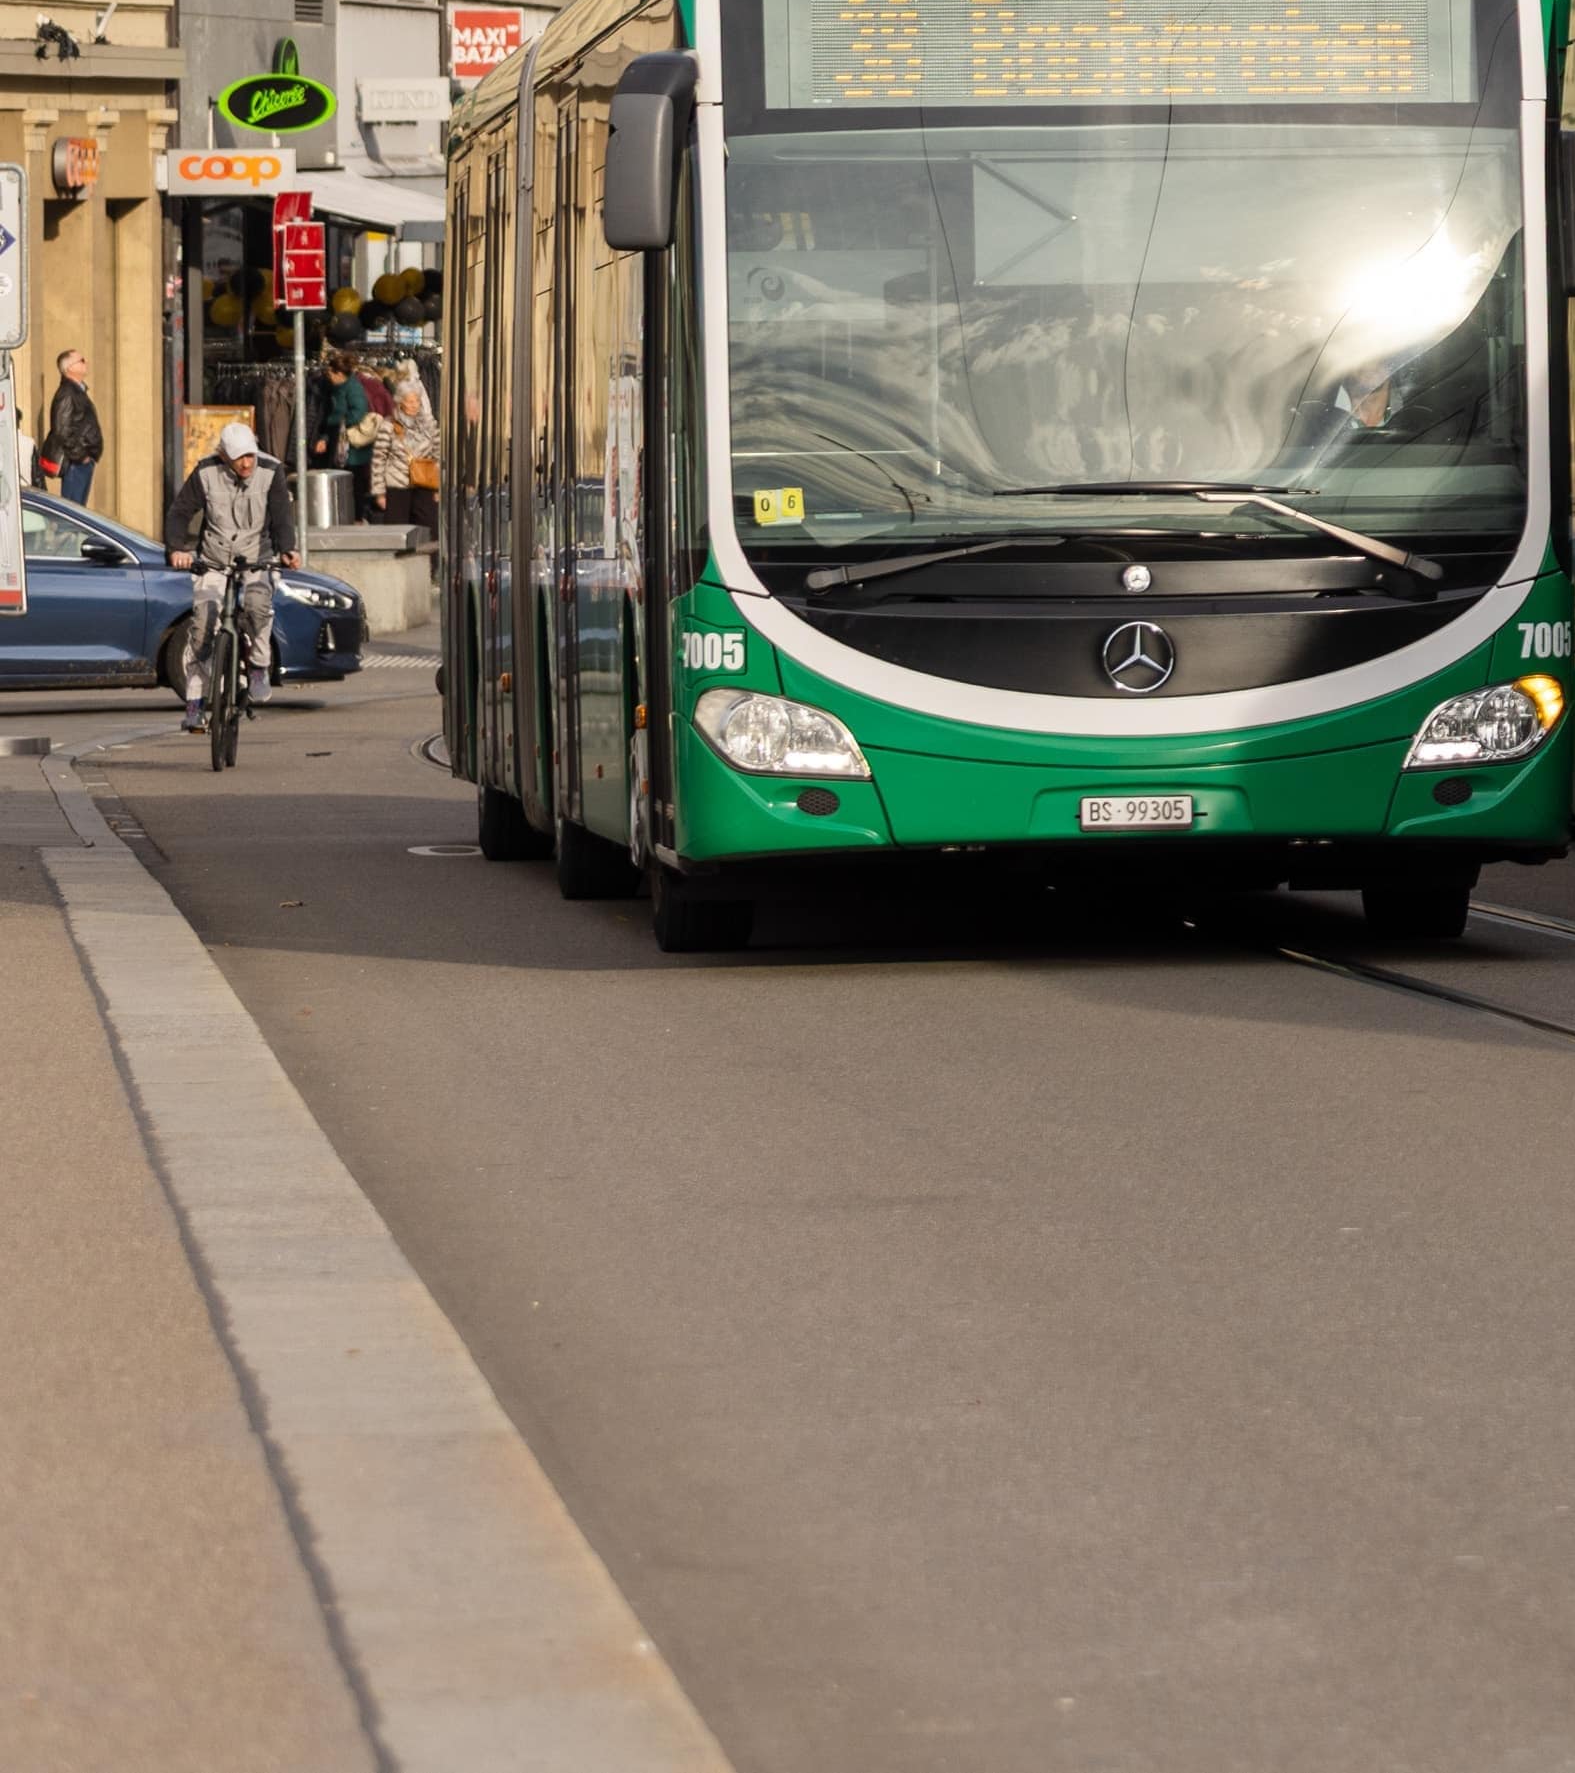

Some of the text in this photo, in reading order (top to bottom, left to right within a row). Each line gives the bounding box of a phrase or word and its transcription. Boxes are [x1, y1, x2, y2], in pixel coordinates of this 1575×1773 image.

[453, 26, 507, 46] MAXI
[179, 155, 282, 187] coop
[682, 631, 745, 671] 7005
[1517, 620, 1572, 659] 7005
[1089, 800, 1185, 822] BS 99305
